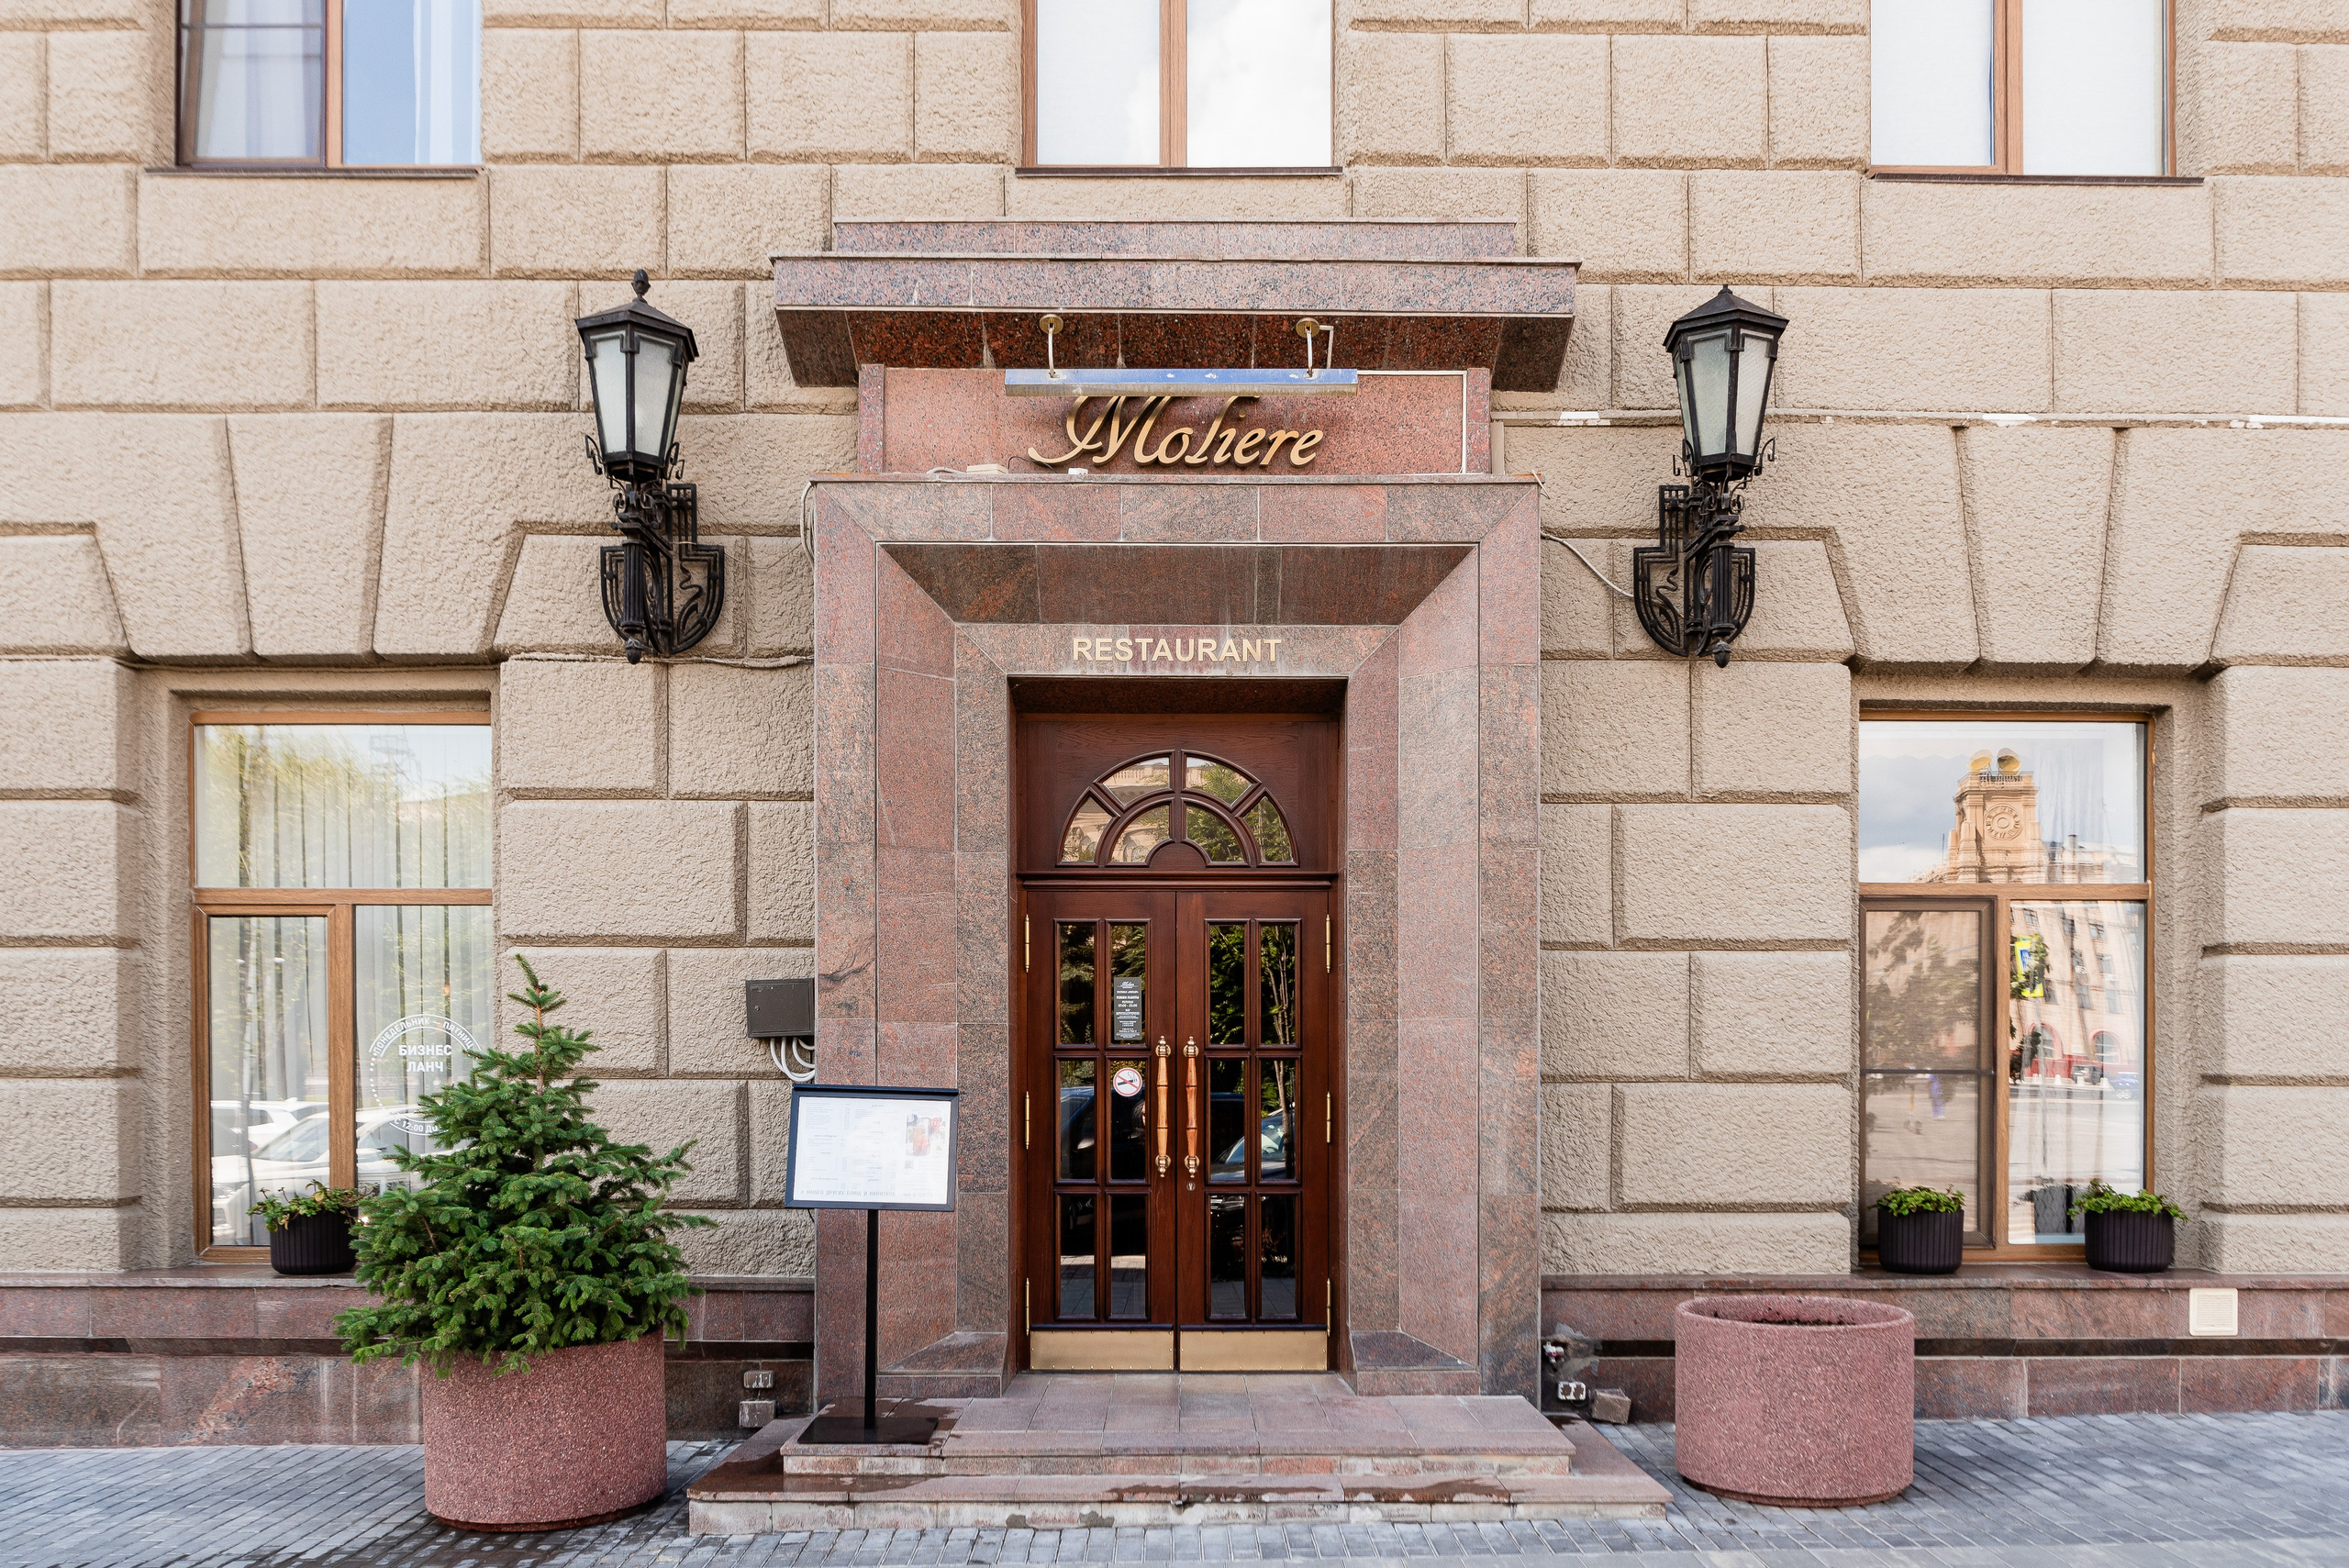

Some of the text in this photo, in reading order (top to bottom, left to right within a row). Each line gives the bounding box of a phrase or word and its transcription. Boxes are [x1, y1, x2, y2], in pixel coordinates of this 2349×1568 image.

[1027, 395, 1324, 468] Moliere
[1073, 638, 1282, 662] RESTAURANT
[373, 1018, 430, 1054] ПОНЕДЕЛЬНИК
[442, 1021, 474, 1050] ПЯТНИЦ
[399, 1044, 452, 1056] БИЗНЕС
[406, 1061, 445, 1073] ЛАНЧ
[402, 1120, 424, 1132] 12:00
